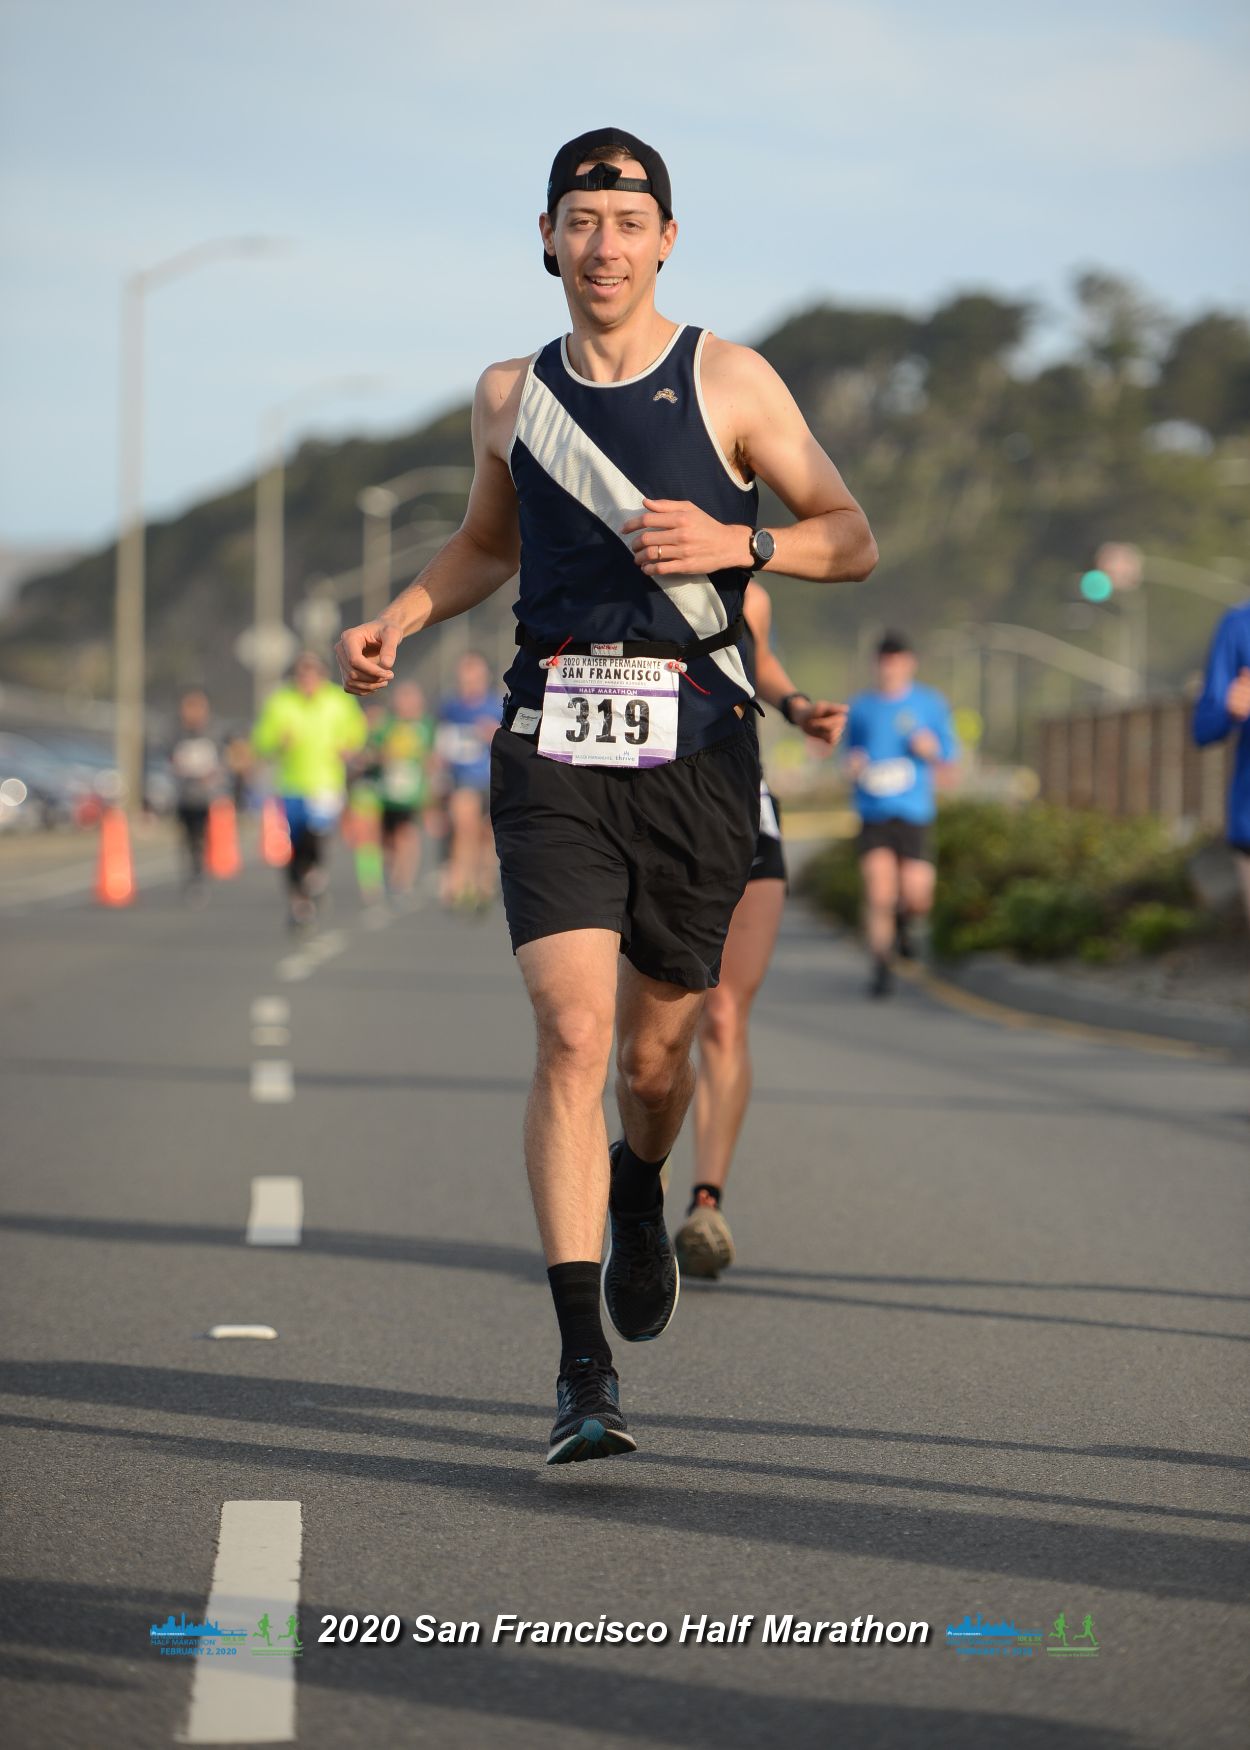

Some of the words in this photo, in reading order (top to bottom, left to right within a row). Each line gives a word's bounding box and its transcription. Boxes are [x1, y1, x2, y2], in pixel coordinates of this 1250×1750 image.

[563, 657, 580, 666] 2020
[582, 657, 607, 667] KAISER
[609, 658, 661, 669] PERMANENTE
[562, 667, 583, 679] SAN
[590, 668, 661, 682] FRANCISCO
[597, 688, 638, 696] MARATHON
[565, 697, 650, 745] 319
[615, 754, 636, 762] thrive
